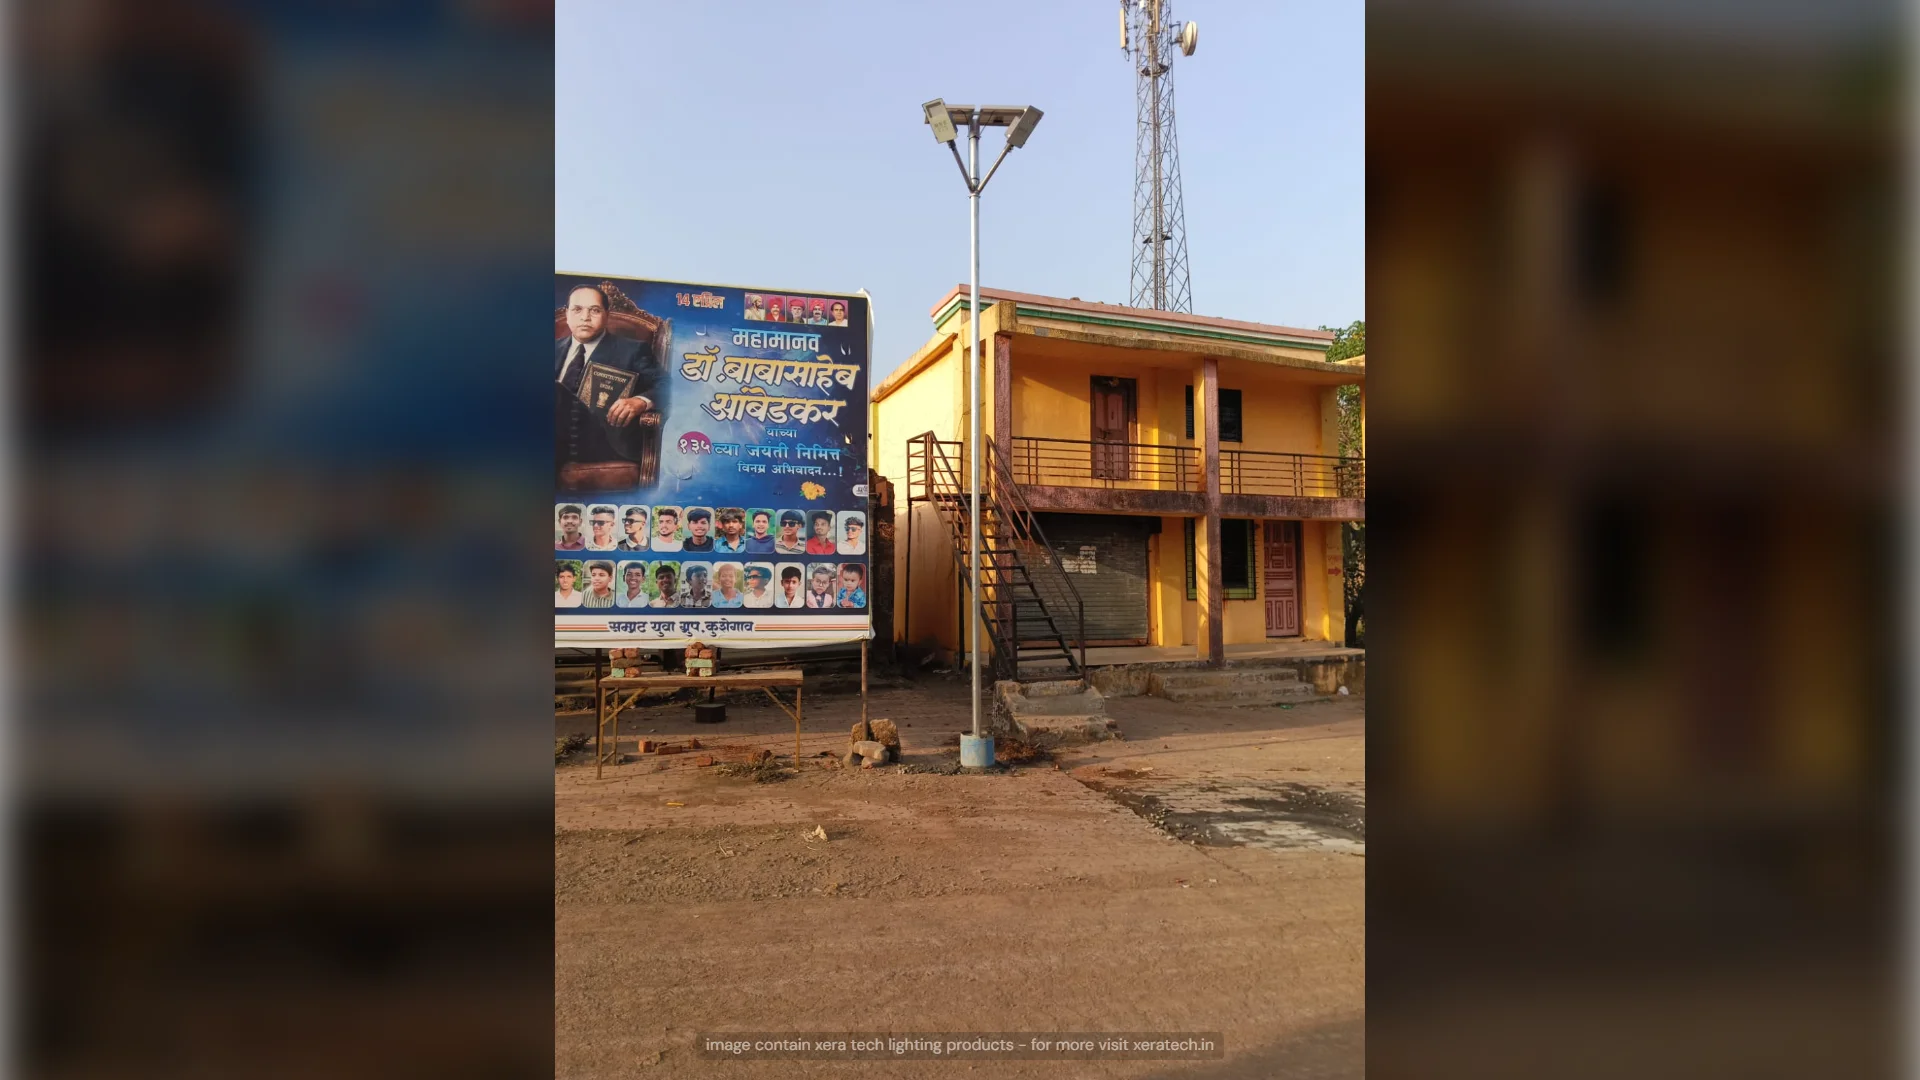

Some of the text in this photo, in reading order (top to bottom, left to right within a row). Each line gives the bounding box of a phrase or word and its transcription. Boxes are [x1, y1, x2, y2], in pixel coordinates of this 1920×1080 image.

[675, 291, 725, 309] 14 एप्रिल
[731, 328, 822, 353] महामानव
[745, 441, 789, 459] जयंती
[795, 443, 841, 461] निमित्त
[736, 461, 766, 474] विनम्र
[650, 621, 676, 637] युवा
